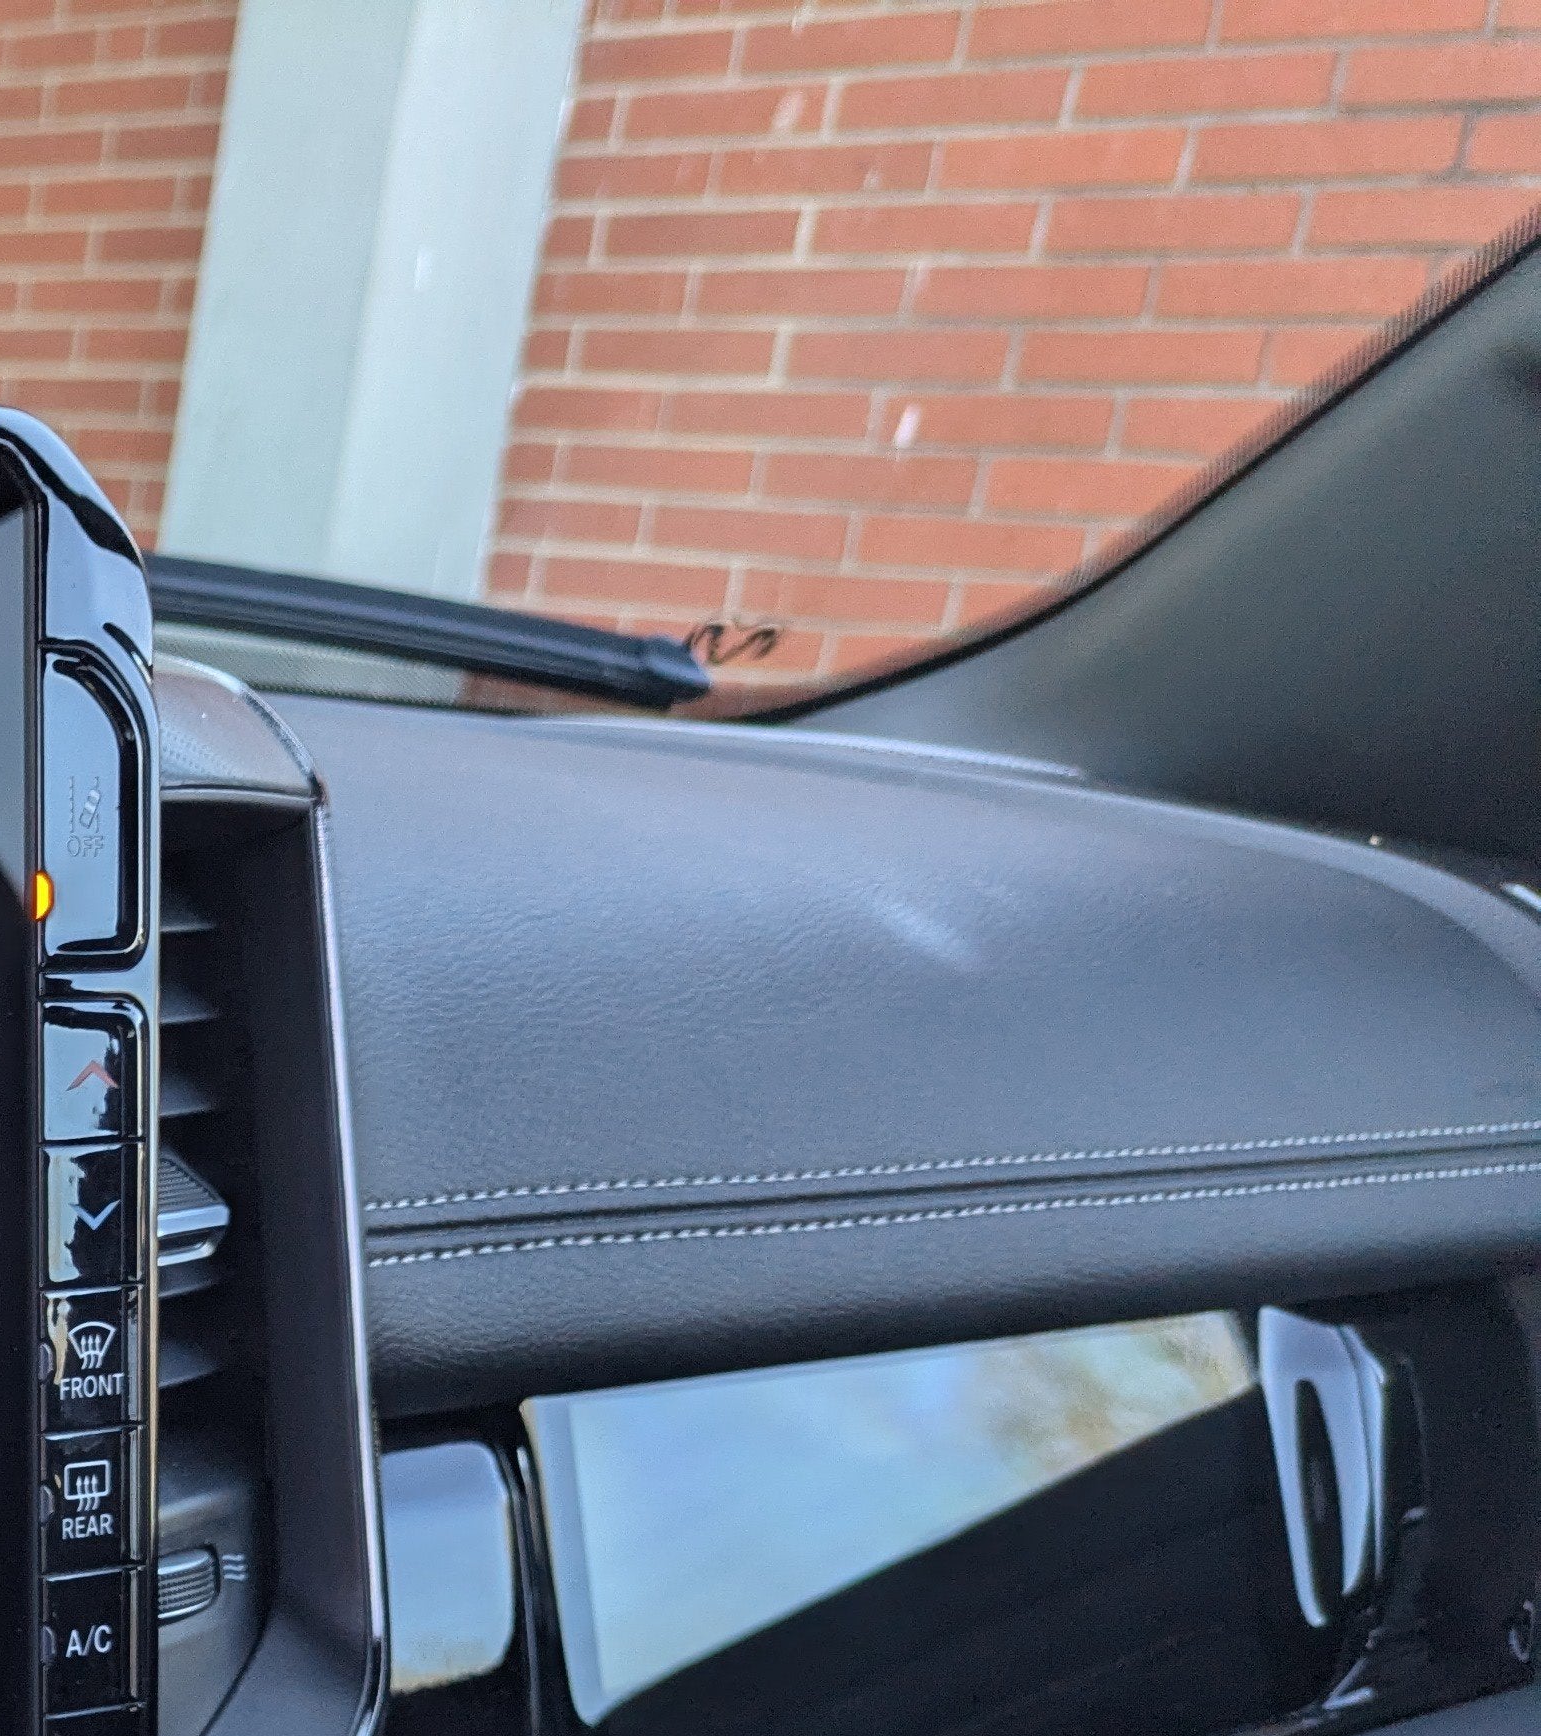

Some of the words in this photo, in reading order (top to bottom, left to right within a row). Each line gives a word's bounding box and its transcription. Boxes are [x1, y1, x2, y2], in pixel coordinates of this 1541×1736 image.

[66, 835, 104, 858] OFF
[59, 1372, 125, 1402] FRONT
[61, 1514, 115, 1541] REAR
[65, 1624, 113, 1659] A/C
